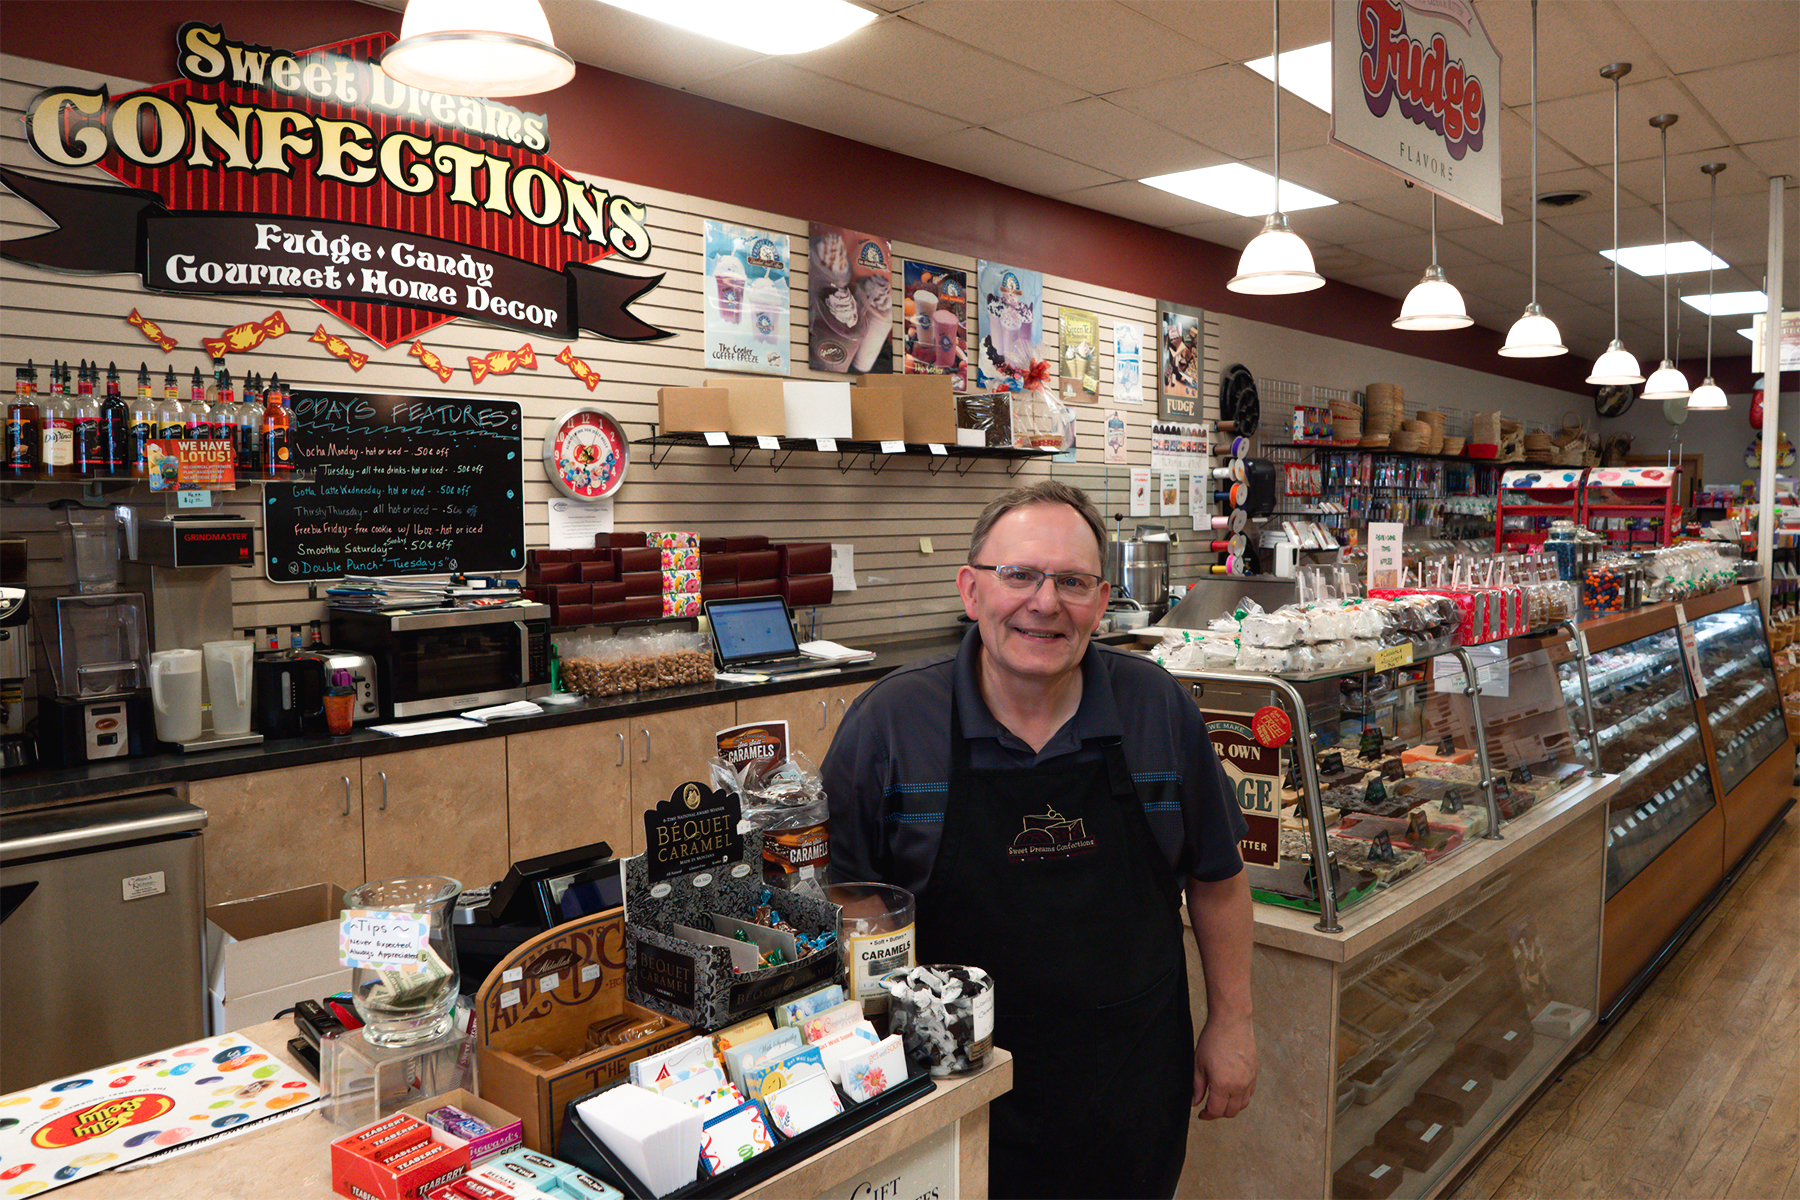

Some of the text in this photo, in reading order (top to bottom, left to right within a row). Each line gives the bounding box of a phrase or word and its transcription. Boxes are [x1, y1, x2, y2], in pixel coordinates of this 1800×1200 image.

[1358, 0, 1485, 144] Fudge
[184, 27, 548, 151] Sweet Dreams
[1399, 141, 1454, 182] FLAVORS
[29, 88, 650, 261] CONFECTIONS
[255, 223, 494, 287] Fudge Candy
[166, 253, 558, 329] Gourmet Home Decor
[1066, 323, 1083, 334] Green
[712, 351, 735, 360] COFFEE
[737, 351, 759, 363] FREEZE
[719, 342, 753, 356] The Cooler
[1166, 398, 1195, 416] FUDGE
[567, 418, 574, 428] 11
[582, 414, 590, 423] 12
[599, 419, 603, 429] 1
[556, 431, 565, 442] 10
[610, 431, 615, 441] 2
[178, 441, 231, 451] WE HAVE
[328, 442, 358, 460] Monday
[365, 447, 376, 456] hot
[436, 448, 450, 457] off
[615, 449, 620, 459] 3
[180, 451, 231, 463] LOTUS!
[555, 450, 560, 460] 9
[319, 463, 355, 479] Tuesday
[362, 465, 371, 475] all
[472, 464, 484, 475] off
[559, 467, 564, 478] 8
[611, 466, 616, 476] 4
[292, 485, 316, 498] Gotta
[388, 484, 399, 496] hot
[457, 485, 472, 497] off
[572, 481, 577, 492] 7
[586, 484, 592, 495] 6
[601, 480, 606, 490] 5
[326, 504, 363, 521] Thursday
[373, 505, 384, 514] all
[388, 503, 400, 514] hot
[184, 533, 248, 541] GRINDMASTER
[323, 522, 348, 538] Friday
[354, 523, 368, 535] free
[371, 525, 393, 534] cookie
[440, 524, 452, 535] hot
[466, 523, 483, 534] iced
[297, 543, 340, 556] Smoothie
[344, 542, 388, 558] Saturday
[436, 539, 454, 551] off
[301, 561, 342, 574] Double
[346, 558, 378, 571] Punch
[1223, 723, 1245, 733] MAKE
[728, 744, 774, 763] CARAMELS
[1228, 743, 1261, 760] OWN
[677, 812, 696, 821] NATIONAL
[710, 806, 725, 814] WINNER
[656, 814, 731, 846] BÉQUET
[658, 833, 733, 862] CARAMEL
[790, 841, 828, 864] CARAMELS
[1008, 839, 1095, 855] Sweet Dreams Confections
[358, 920, 388, 937] Tips
[350, 938, 413, 949] Never Expected
[873, 938, 886, 946] Soft
[349, 948, 419, 960] Always Appreciated
[861, 940, 911, 961] CARAMELS
[640, 966, 690, 995] CARAMEL
[828, 1036, 841, 1047] Well
[796, 1055, 807, 1064] Well
[868, 1052, 880, 1066] get
[885, 1039, 902, 1056] SOON
[585, 1057, 627, 1090] THE
[78, 1097, 147, 1126] Belly
[72, 1111, 135, 1138] Jelly
[359, 1116, 405, 1140] TEABERRY
[372, 1123, 419, 1147] TEABERRY
[383, 1140, 429, 1164] TEABERRY
[396, 1145, 443, 1171] TEABERRY
[418, 1166, 465, 1196] TEABERRY
